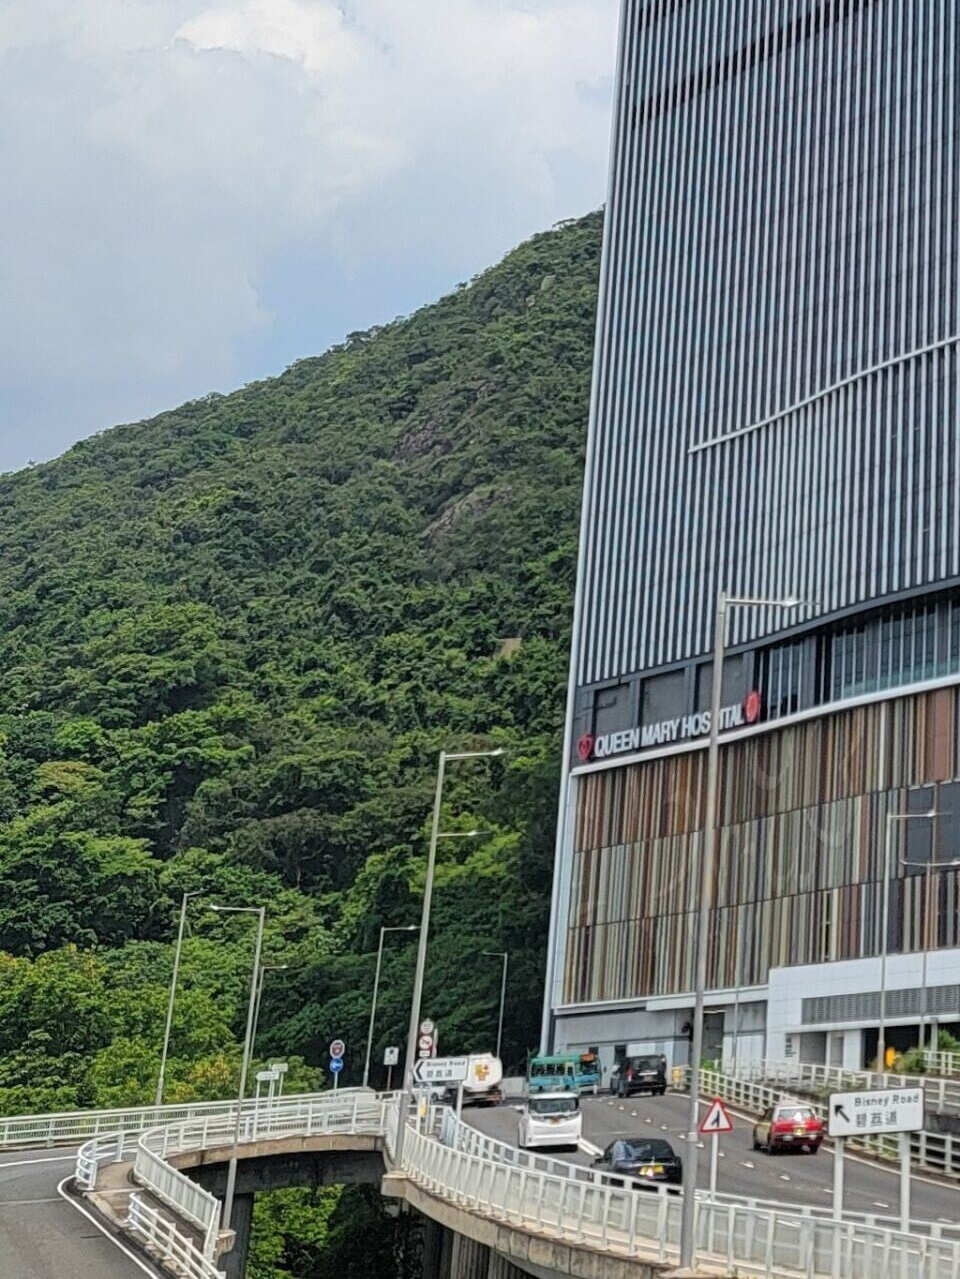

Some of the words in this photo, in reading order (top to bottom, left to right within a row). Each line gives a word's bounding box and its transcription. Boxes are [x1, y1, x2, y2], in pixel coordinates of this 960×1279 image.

[594, 728, 640, 757] QUEEN
[641, 719, 680, 747] MARY
[681, 703, 745, 738] HOSITAL
[854, 1097, 889, 1107] Bisney
[892, 1094, 919, 1104] Road
